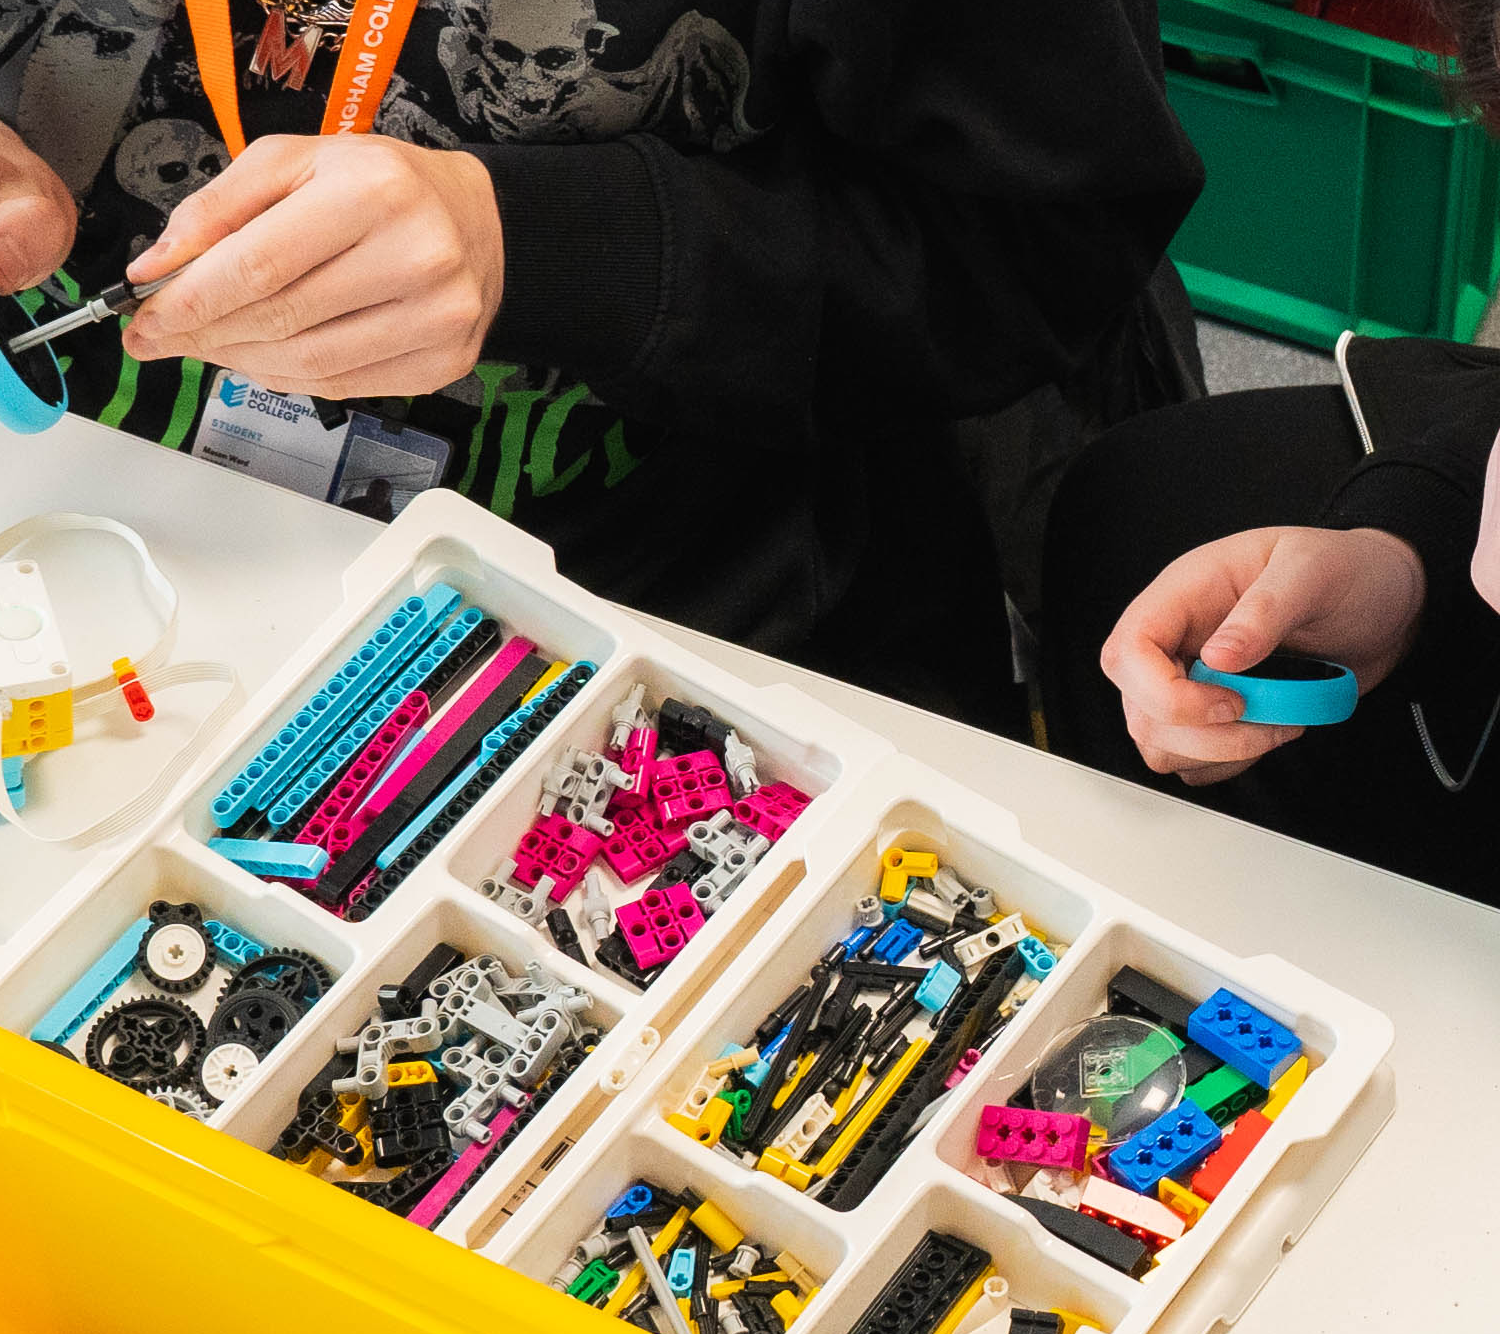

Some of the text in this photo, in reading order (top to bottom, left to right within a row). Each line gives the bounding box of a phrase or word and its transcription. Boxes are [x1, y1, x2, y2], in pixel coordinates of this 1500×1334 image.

[249, 8, 323, 91] M
[338, 53, 377, 135] NGHAM
[247, 400, 300, 424] COLLEGE
[250, 388, 319, 420] NOTTINGHA
[211, 419, 264, 442] STUDENT
